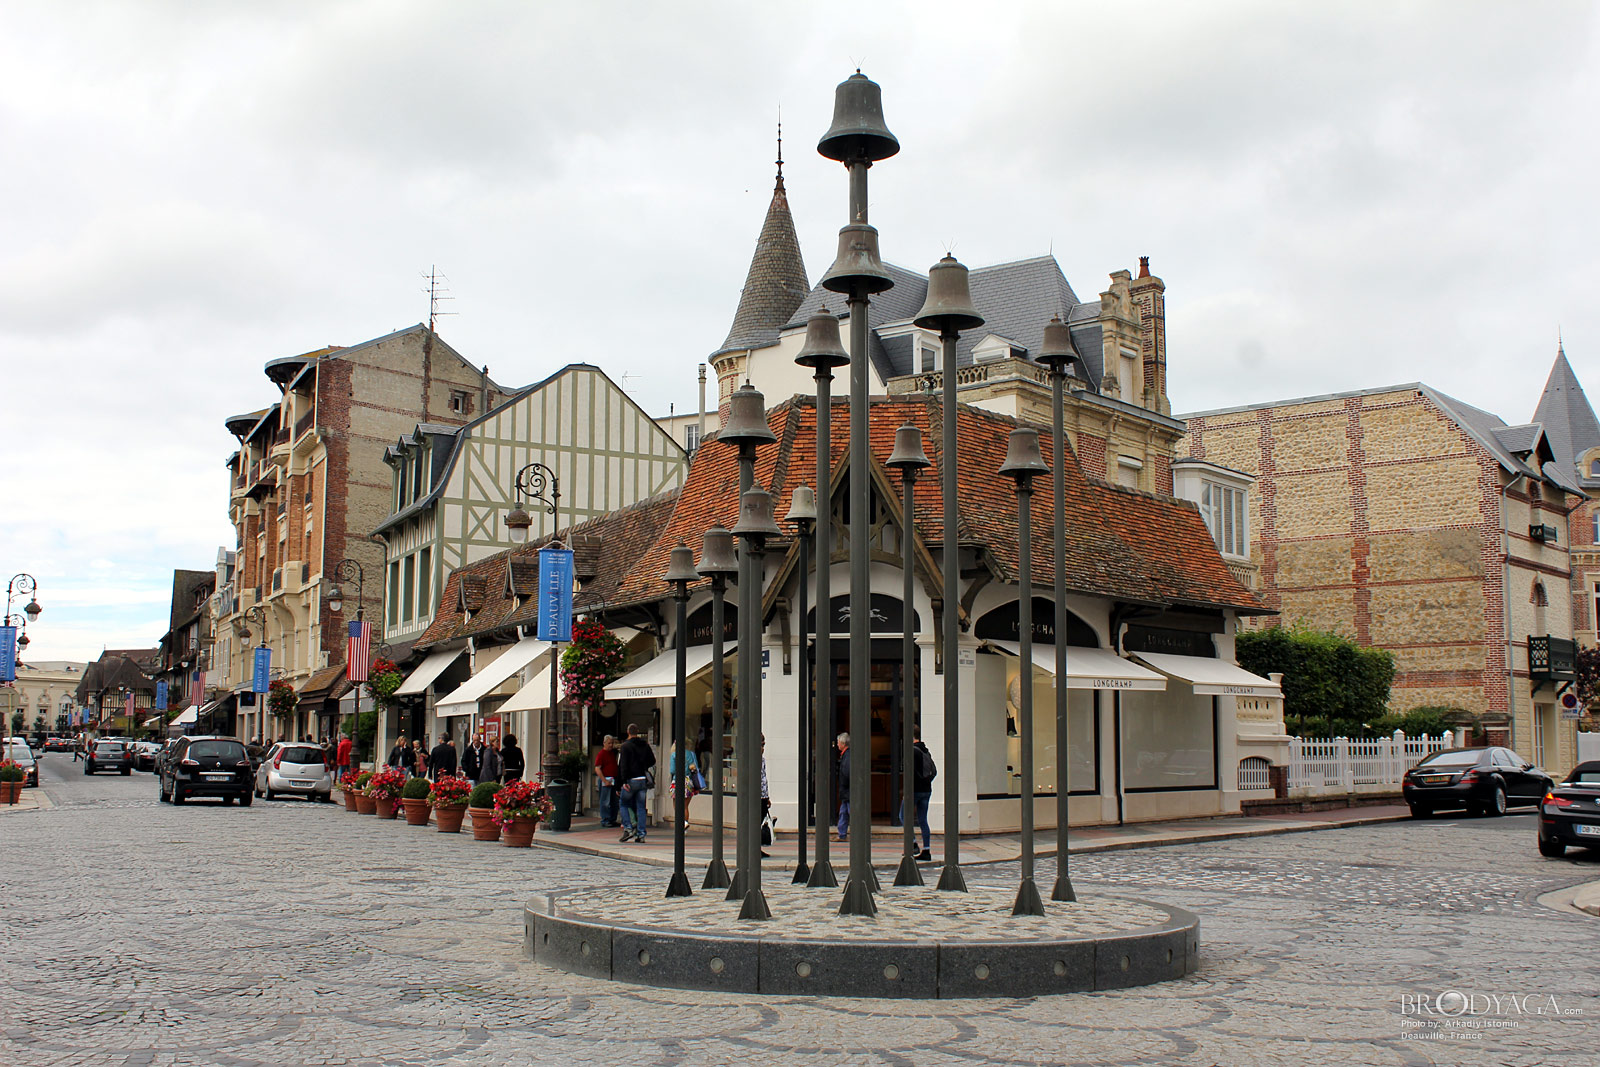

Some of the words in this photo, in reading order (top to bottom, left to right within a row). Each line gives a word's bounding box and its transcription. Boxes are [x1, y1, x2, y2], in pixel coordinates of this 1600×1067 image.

[693, 622, 733, 638] LONGCMP
[1093, 679, 1133, 688] LONGCHAMP
[626, 688, 653, 697] LONGCHAMP
[1223, 686, 1254, 694] LONGCHAMP
